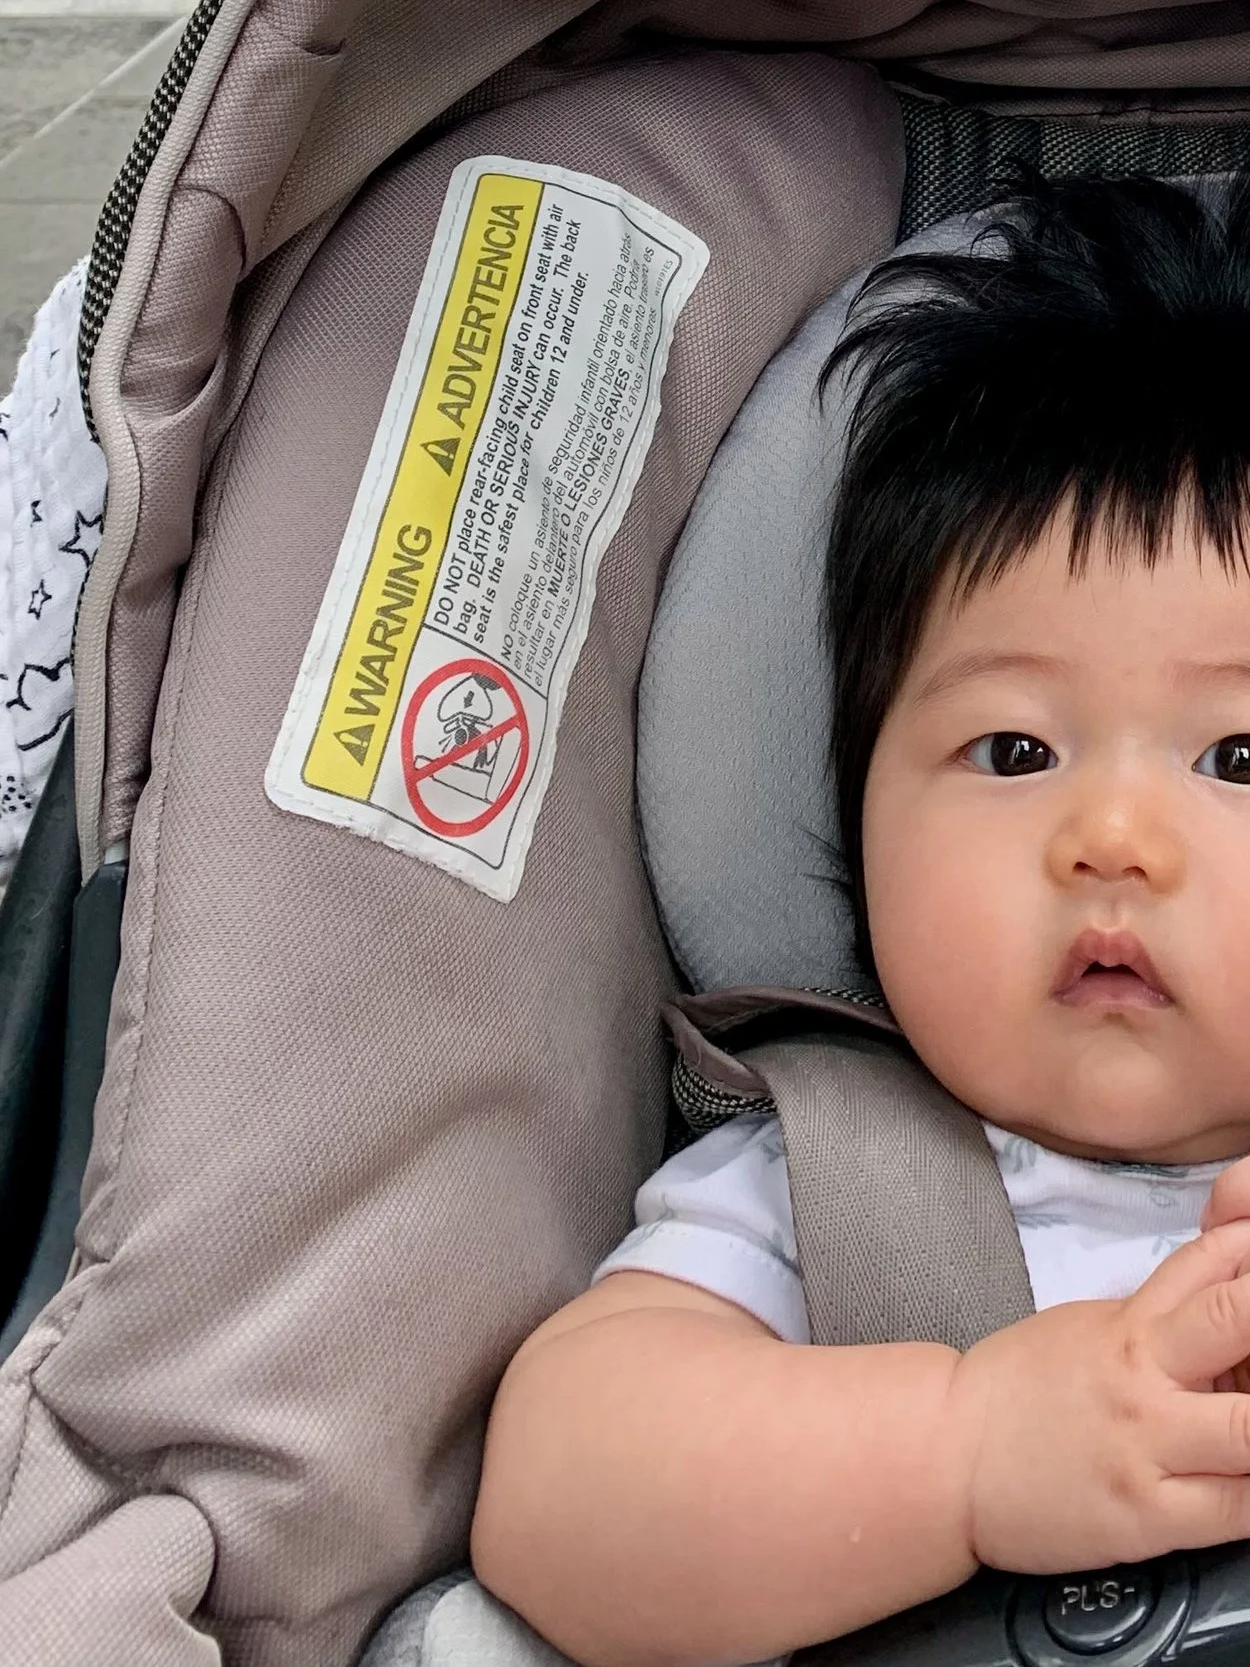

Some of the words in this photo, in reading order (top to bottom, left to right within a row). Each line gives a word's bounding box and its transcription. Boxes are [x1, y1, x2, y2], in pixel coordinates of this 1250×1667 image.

[547, 204, 563, 222] air
[541, 224, 559, 251] with
[560, 220, 581, 252] back
[535, 253, 551, 283] seat
[553, 254, 572, 278] The
[642, 246, 655, 264] es
[567, 272, 589, 315] under.
[607, 264, 627, 298] hacia
[521, 284, 544, 319] front
[543, 288, 564, 330] occur.
[517, 322, 533, 342] on
[559, 314, 576, 346] and
[593, 299, 617, 359] orientado
[611, 329, 627, 348] de
[629, 304, 646, 350] asiento
[510, 342, 527, 375] seat
[533, 333, 550, 360] can
[550, 346, 567, 363] 12
[624, 348, 636, 365] el
[578, 358, 600, 404] infantil
[599, 349, 620, 385] bolsa
[637, 362, 646, 372] y
[498, 374, 519, 415] child
[512, 359, 541, 420] INJURY
[530, 369, 561, 430] children
[593, 386, 610, 413] con
[627, 369, 644, 407] años
[618, 404, 634, 424] 12
[519, 430, 535, 457] for
[548, 403, 586, 474] seguridad
[563, 412, 599, 481] automóvil
[611, 426, 625, 447] de
[344, 524, 432, 716] WARNING
[437, 205, 524, 429] ADVERTENCIA
[470, 417, 507, 506] rear-facing
[490, 420, 520, 497] SERIOUS
[564, 432, 607, 512] LESIONES
[598, 447, 617, 486] niños
[512, 458, 529, 503] place
[541, 475, 554, 496] de
[552, 480, 568, 505] del
[481, 499, 500, 526] OR
[582, 487, 602, 509] los
[457, 509, 476, 554] place
[497, 503, 519, 554] safest
[534, 497, 550, 549] asiento
[560, 512, 572, 528] O
[572, 511, 589, 545] para
[443, 552, 466, 594] NOT
[467, 528, 492, 588] DEATH
[488, 557, 504, 584] the
[527, 550, 541, 572] un
[547, 528, 568, 597] MUERTE
[564, 545, 578, 595] seguro
[433, 597, 454, 626] DO
[481, 586, 497, 604] is
[509, 573, 533, 632] coloque
[523, 576, 547, 630] asiento
[541, 599, 555, 620] en
[453, 600, 477, 634] bag.
[474, 605, 492, 644] seat
[500, 633, 514, 662] NO
[517, 629, 528, 648] el
[524, 621, 545, 679] resultar
[536, 630, 556, 670] lugar
[513, 649, 524, 671] en
[533, 670, 544, 688] el
